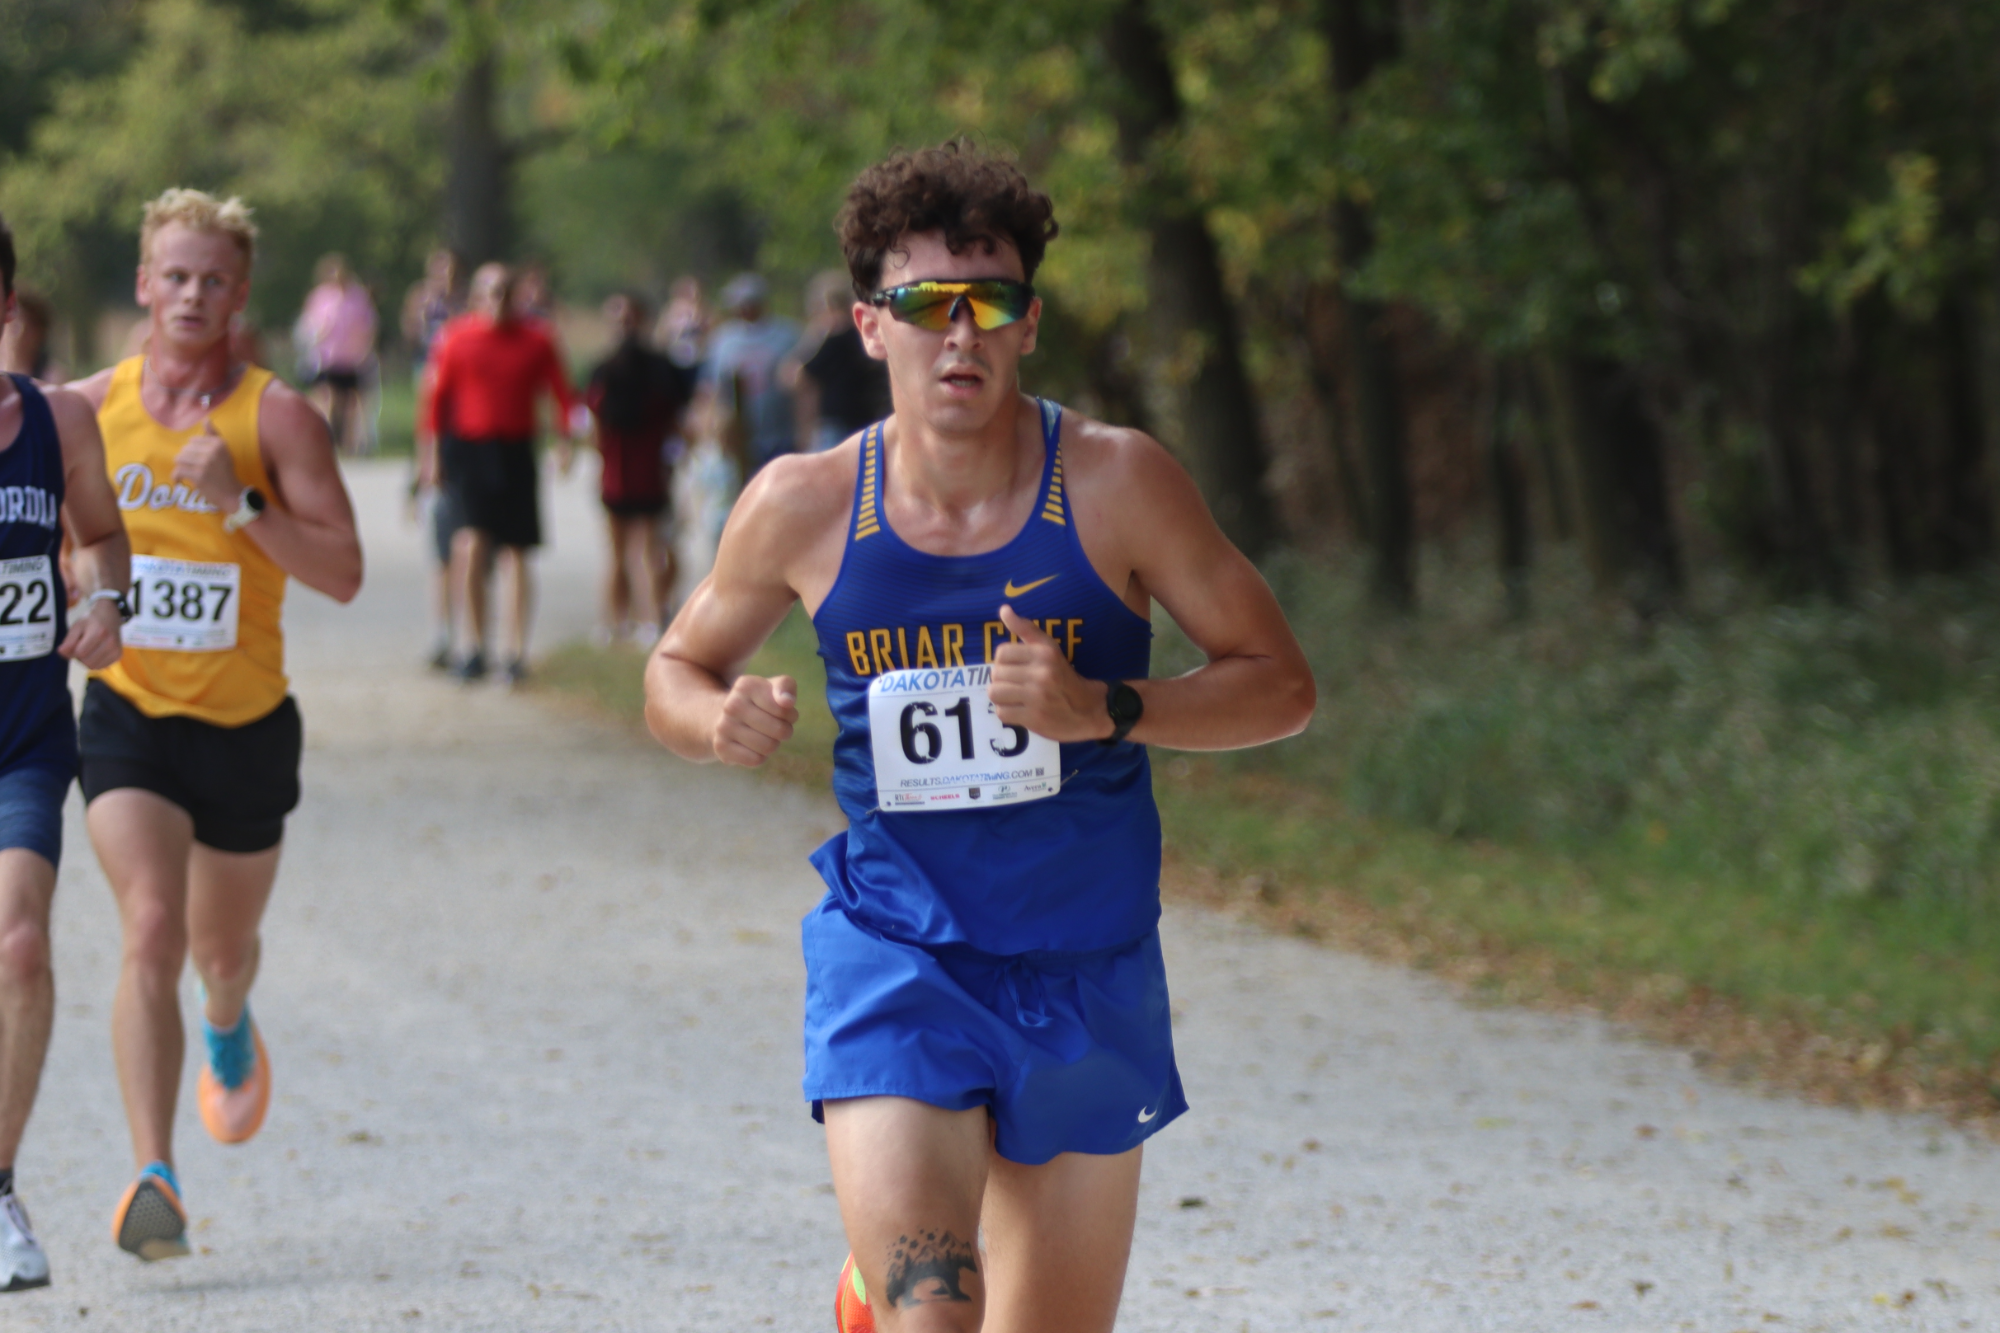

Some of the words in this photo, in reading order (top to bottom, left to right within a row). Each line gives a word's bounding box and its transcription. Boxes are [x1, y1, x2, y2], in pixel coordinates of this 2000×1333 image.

[115, 462, 218, 514] Dor
[132, 577, 232, 622] 1387
[847, 623, 964, 675] BRIAR
[983, 618, 1083, 664] CFF
[880, 665, 992, 693] DAKOTATIM
